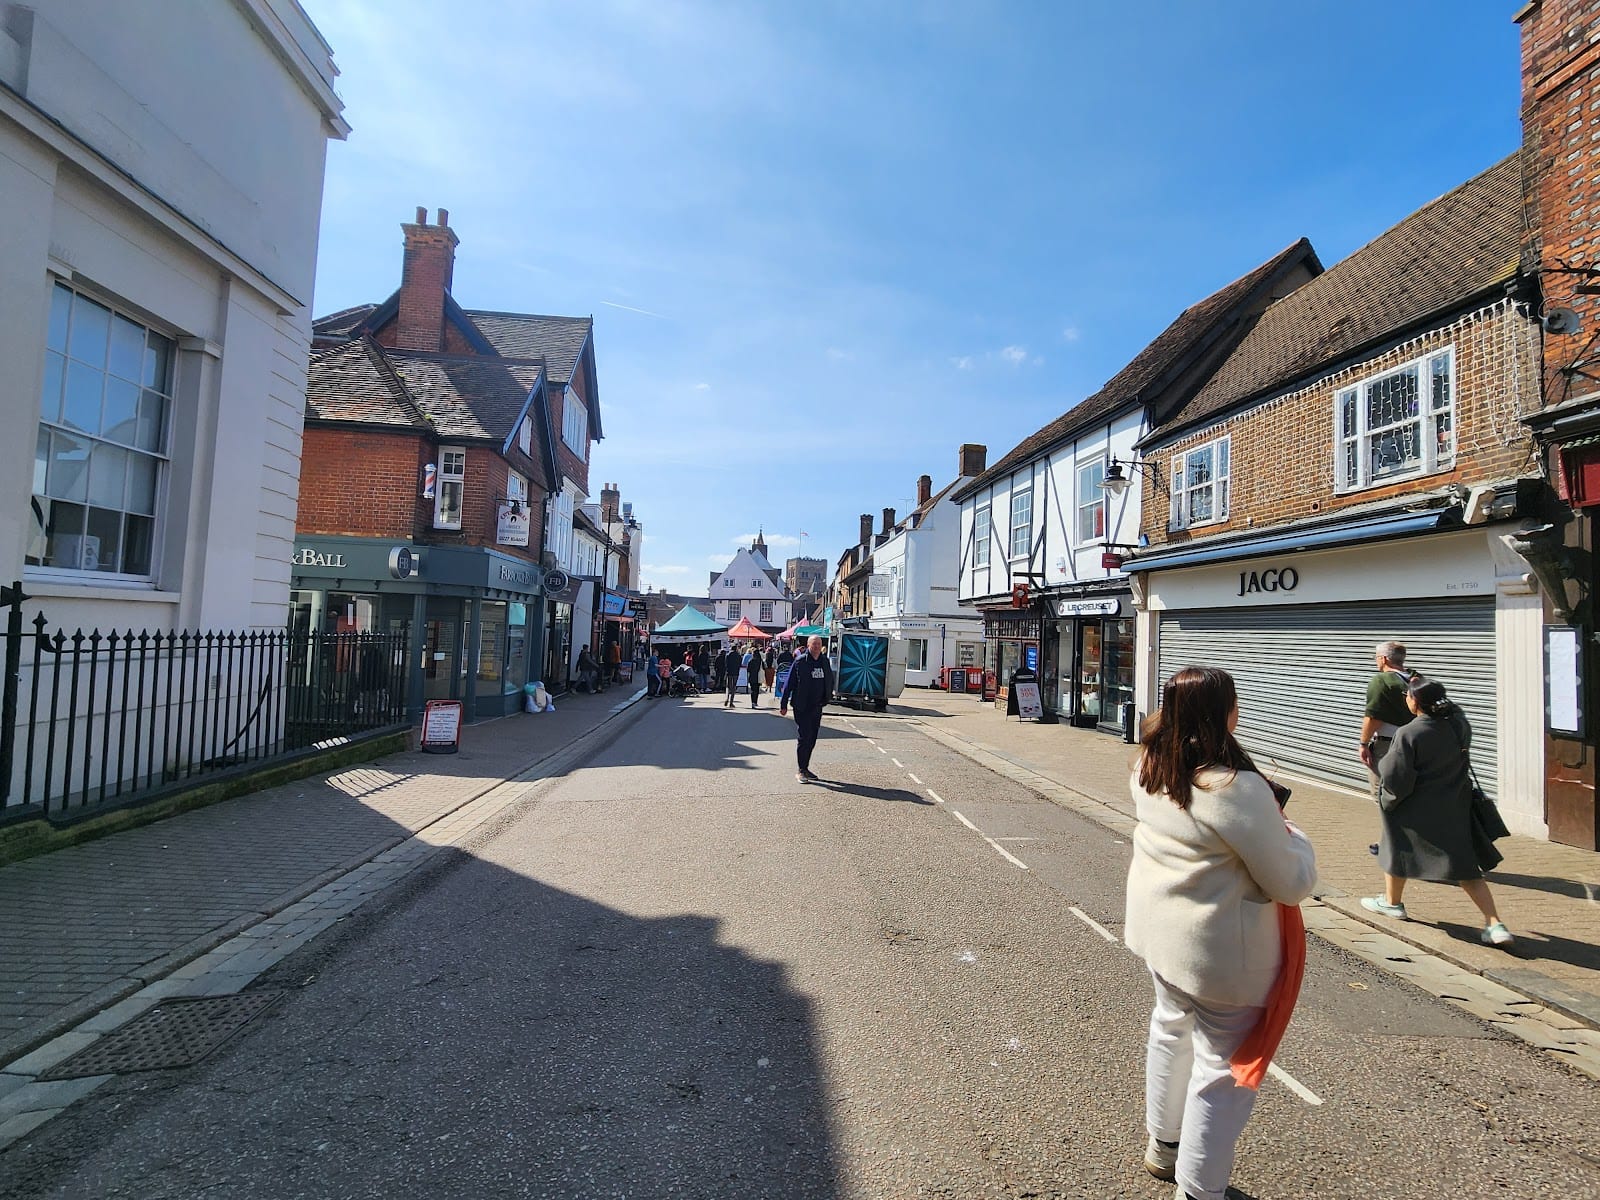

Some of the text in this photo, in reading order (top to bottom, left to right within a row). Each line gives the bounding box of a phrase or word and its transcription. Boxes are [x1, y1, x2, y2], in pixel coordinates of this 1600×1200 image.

[399, 557, 409, 569] FB
[549, 577, 562, 586] FB
[1237, 568, 1299, 596] JAGO
